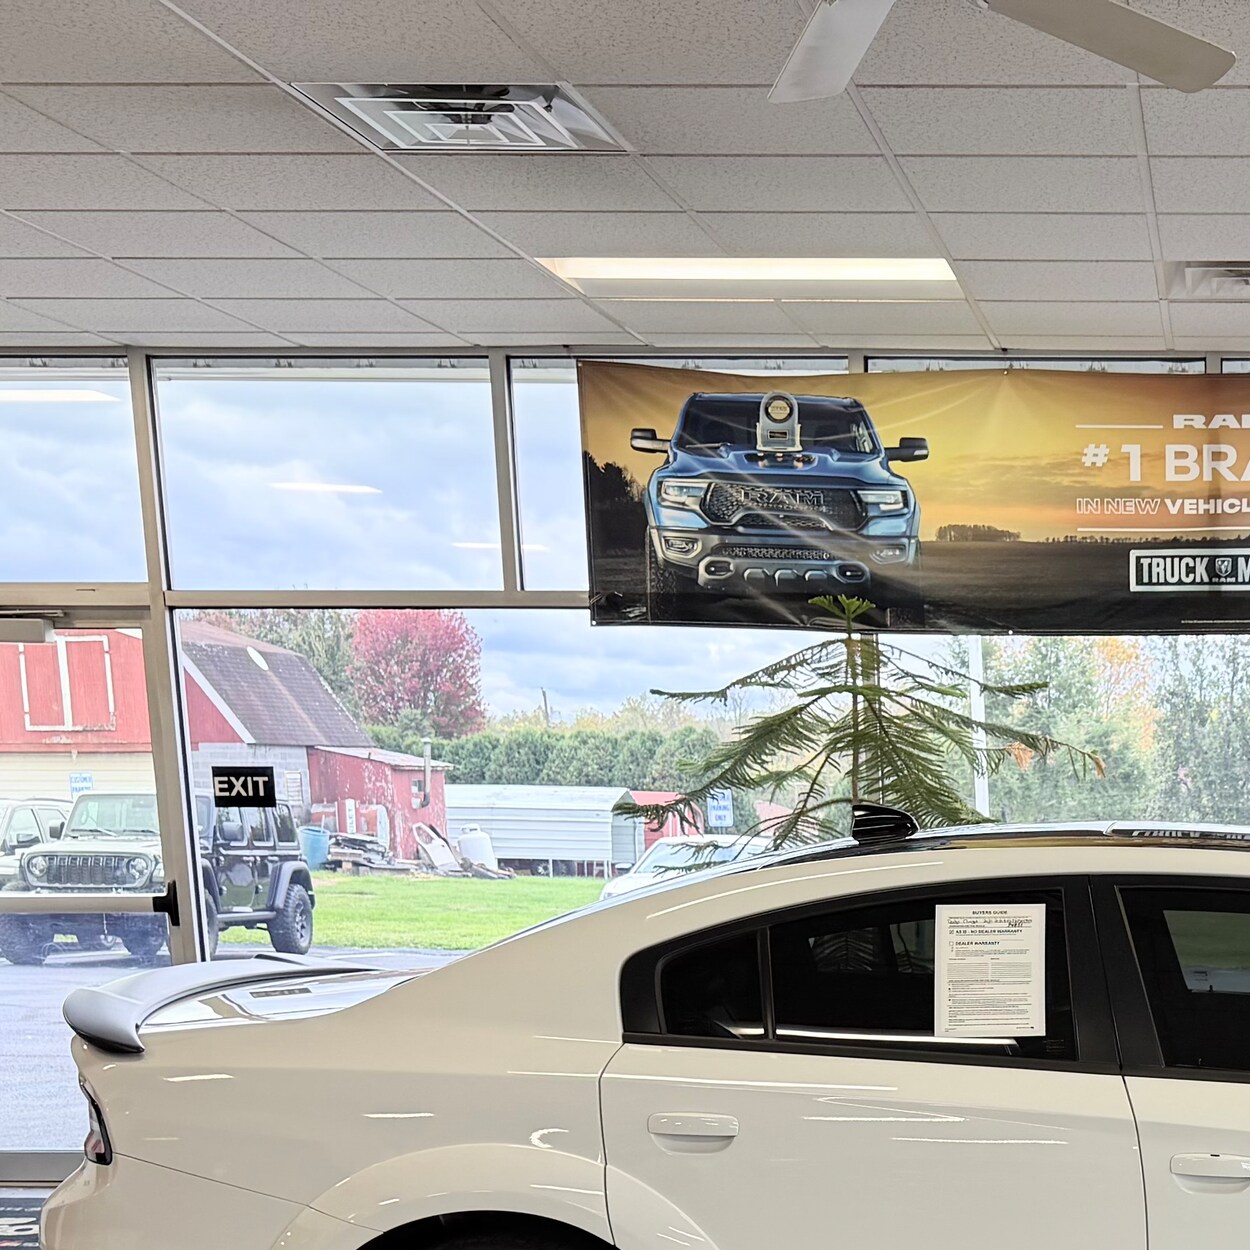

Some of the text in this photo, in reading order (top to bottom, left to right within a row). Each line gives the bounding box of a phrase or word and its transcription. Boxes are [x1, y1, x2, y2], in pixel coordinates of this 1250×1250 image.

[741, 488, 825, 506] RAM
[1076, 497, 1101, 515] IN
[1104, 497, 1161, 515] NEW
[1140, 556, 1210, 584] TRUCK
[213, 776, 269, 797] EXIT
